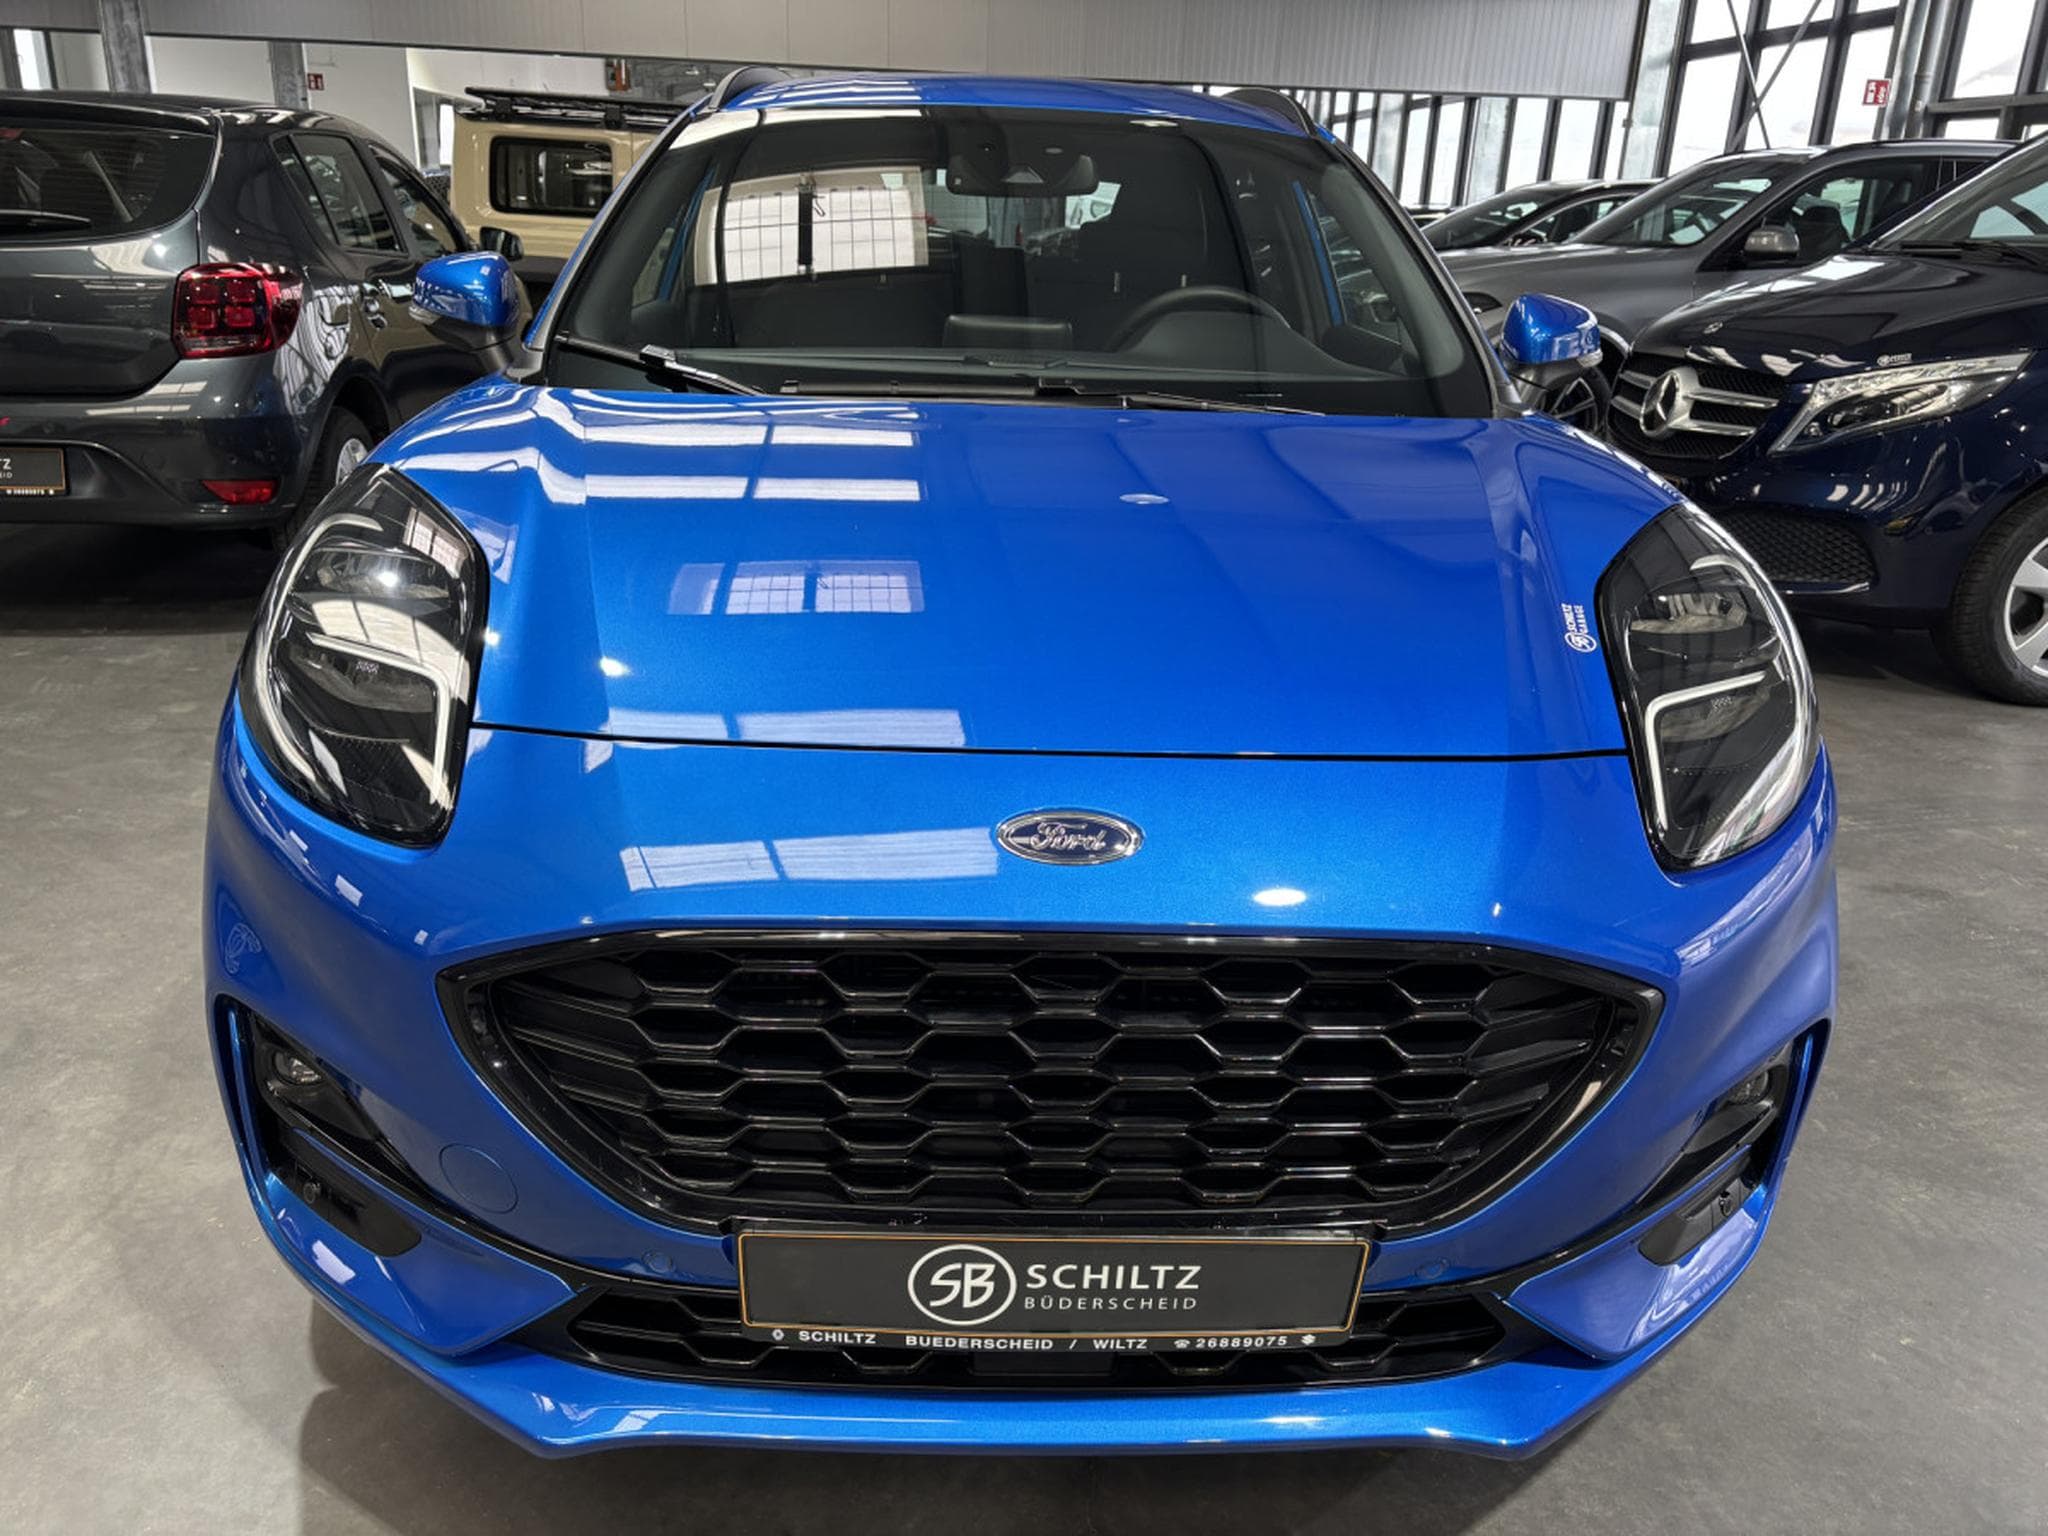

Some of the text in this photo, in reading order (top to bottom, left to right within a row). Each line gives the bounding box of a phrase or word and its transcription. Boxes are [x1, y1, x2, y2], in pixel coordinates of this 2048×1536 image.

[1030, 822, 1107, 850] Ford
[929, 1262, 996, 1308] SB
[1026, 1263, 1202, 1290] SCHILTZ
[1024, 1295, 1197, 1311] BÜDERSCHEID
[799, 1330, 876, 1345] SCHILTZ
[905, 1334, 1054, 1350] BUEDERSCHEID
[1093, 1338, 1148, 1350] WILTZ
[1196, 1335, 1288, 1349] 26889075
